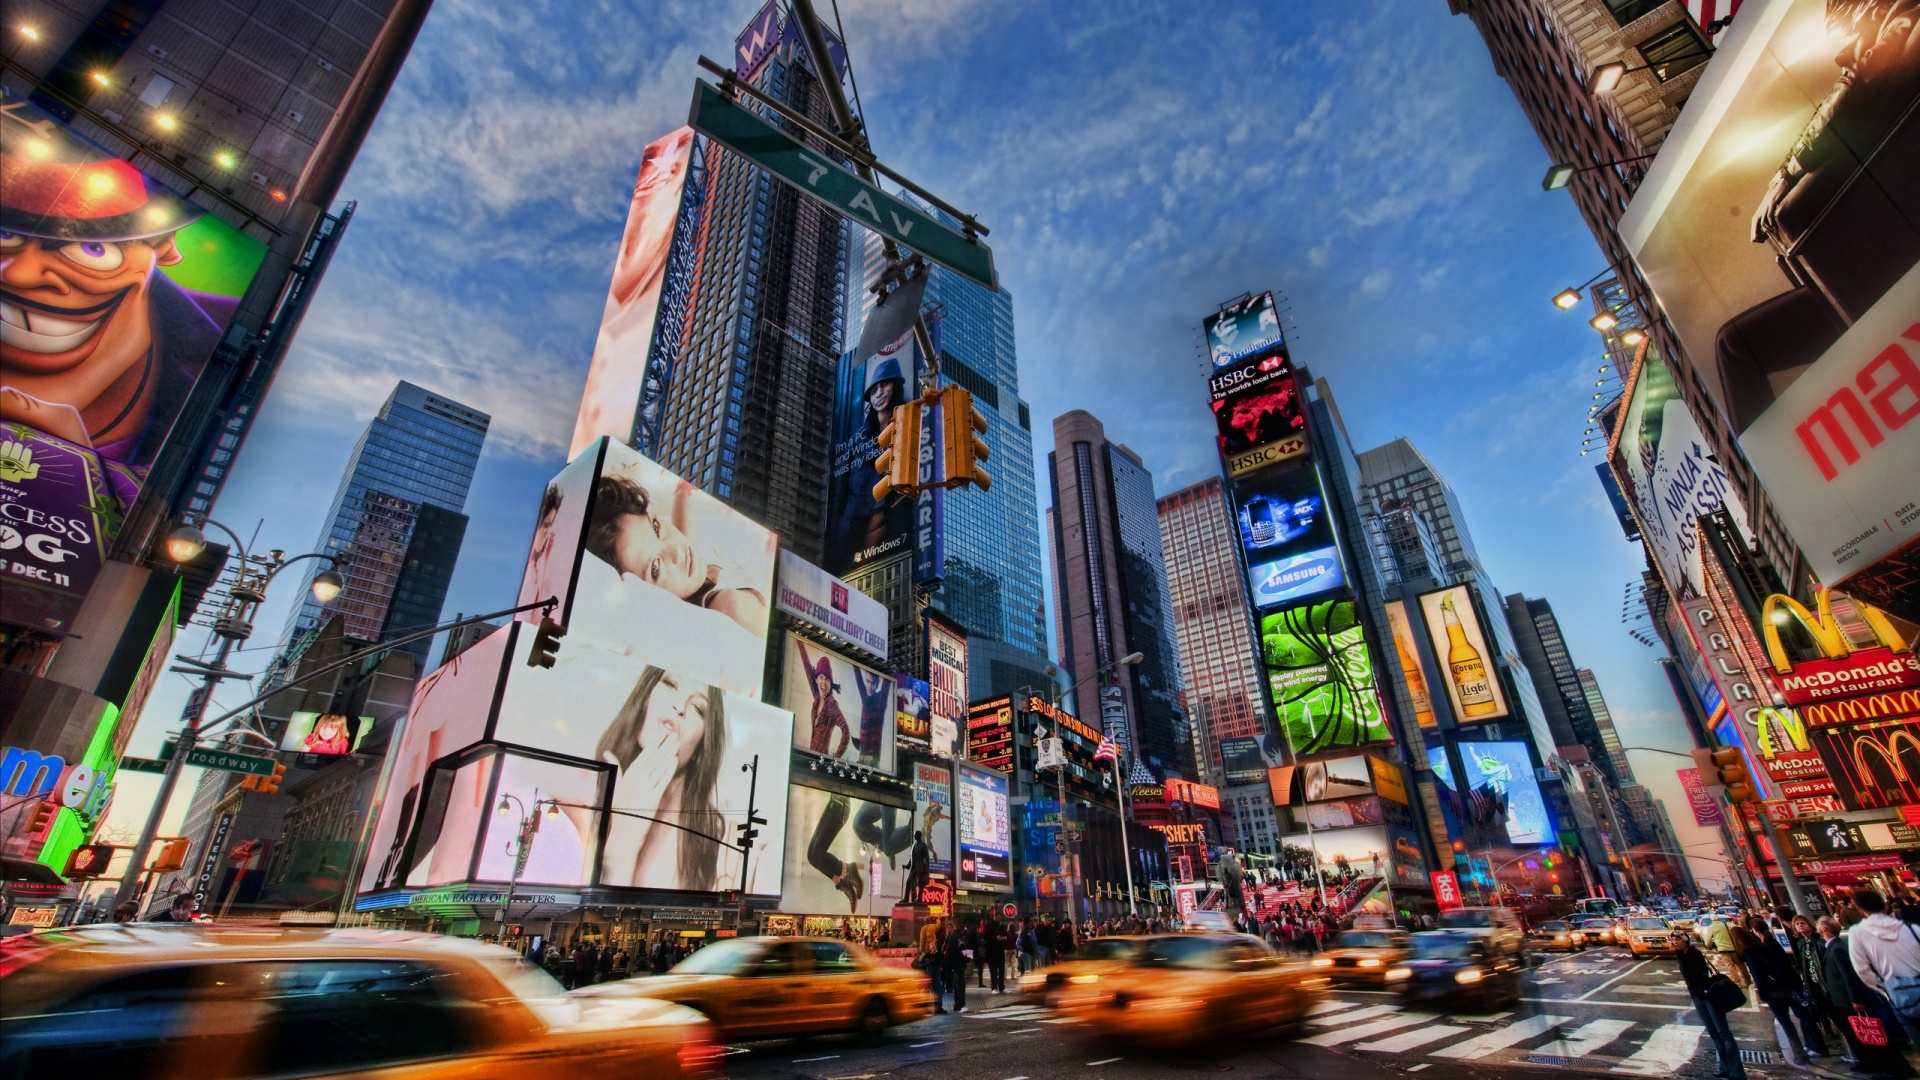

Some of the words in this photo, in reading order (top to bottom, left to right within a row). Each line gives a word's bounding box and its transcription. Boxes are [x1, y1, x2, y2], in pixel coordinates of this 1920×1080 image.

[799, 152, 828, 187] 7
[1231, 332, 1282, 360] Prudential
[1211, 365, 1256, 392] HSBC
[1213, 390, 1227, 400] The
[1228, 381, 1252, 396] world's
[1252, 374, 1269, 386] local
[1270, 367, 1288, 379] bank
[1795, 321, 1920, 482] ma
[835, 449, 850, 466] and
[1230, 447, 1278, 473] HSBC
[1664, 452, 1701, 521] NINJA
[1894, 502, 1917, 518] DATA
[863, 536, 901, 559] Windows
[901, 533, 908, 544] 7
[1832, 525, 1880, 557] RECORDABLE
[918, 561, 932, 571] NYC
[1836, 548, 1861, 565] MEDIA
[12, 561, 52, 582] DEC.
[54, 572, 70, 587] 11
[1268, 565, 1326, 587] SAMSUNG
[781, 587, 813, 615] READY
[812, 603, 830, 624] FOR
[829, 611, 865, 641] HOLIDAY
[864, 630, 886, 653] CHEER
[931, 647, 964, 673] MUSICAL
[939, 640, 957, 658] BEST
[932, 661, 954, 695] BILLY
[1270, 672, 1295, 683] display
[1295, 665, 1328, 676] powered
[1451, 661, 1484, 675] Corona
[1782, 656, 1920, 691] McDonald's
[1284, 677, 1300, 687] wind
[1301, 674, 1327, 684] energy
[1461, 682, 1487, 696] Light
[1810, 675, 1904, 698] Restaurant
[191, 752, 259, 773] roadway
[1131, 785, 1163, 796] Reese's
[1785, 785, 1812, 794] OPEN
[1149, 823, 1204, 842] SHEY'S
[411, 894, 450, 904] AMERICAN
[452, 893, 487, 903] EAGLE
[1437, 873, 1454, 903] tkts
[1182, 891, 1193, 916] tkts
